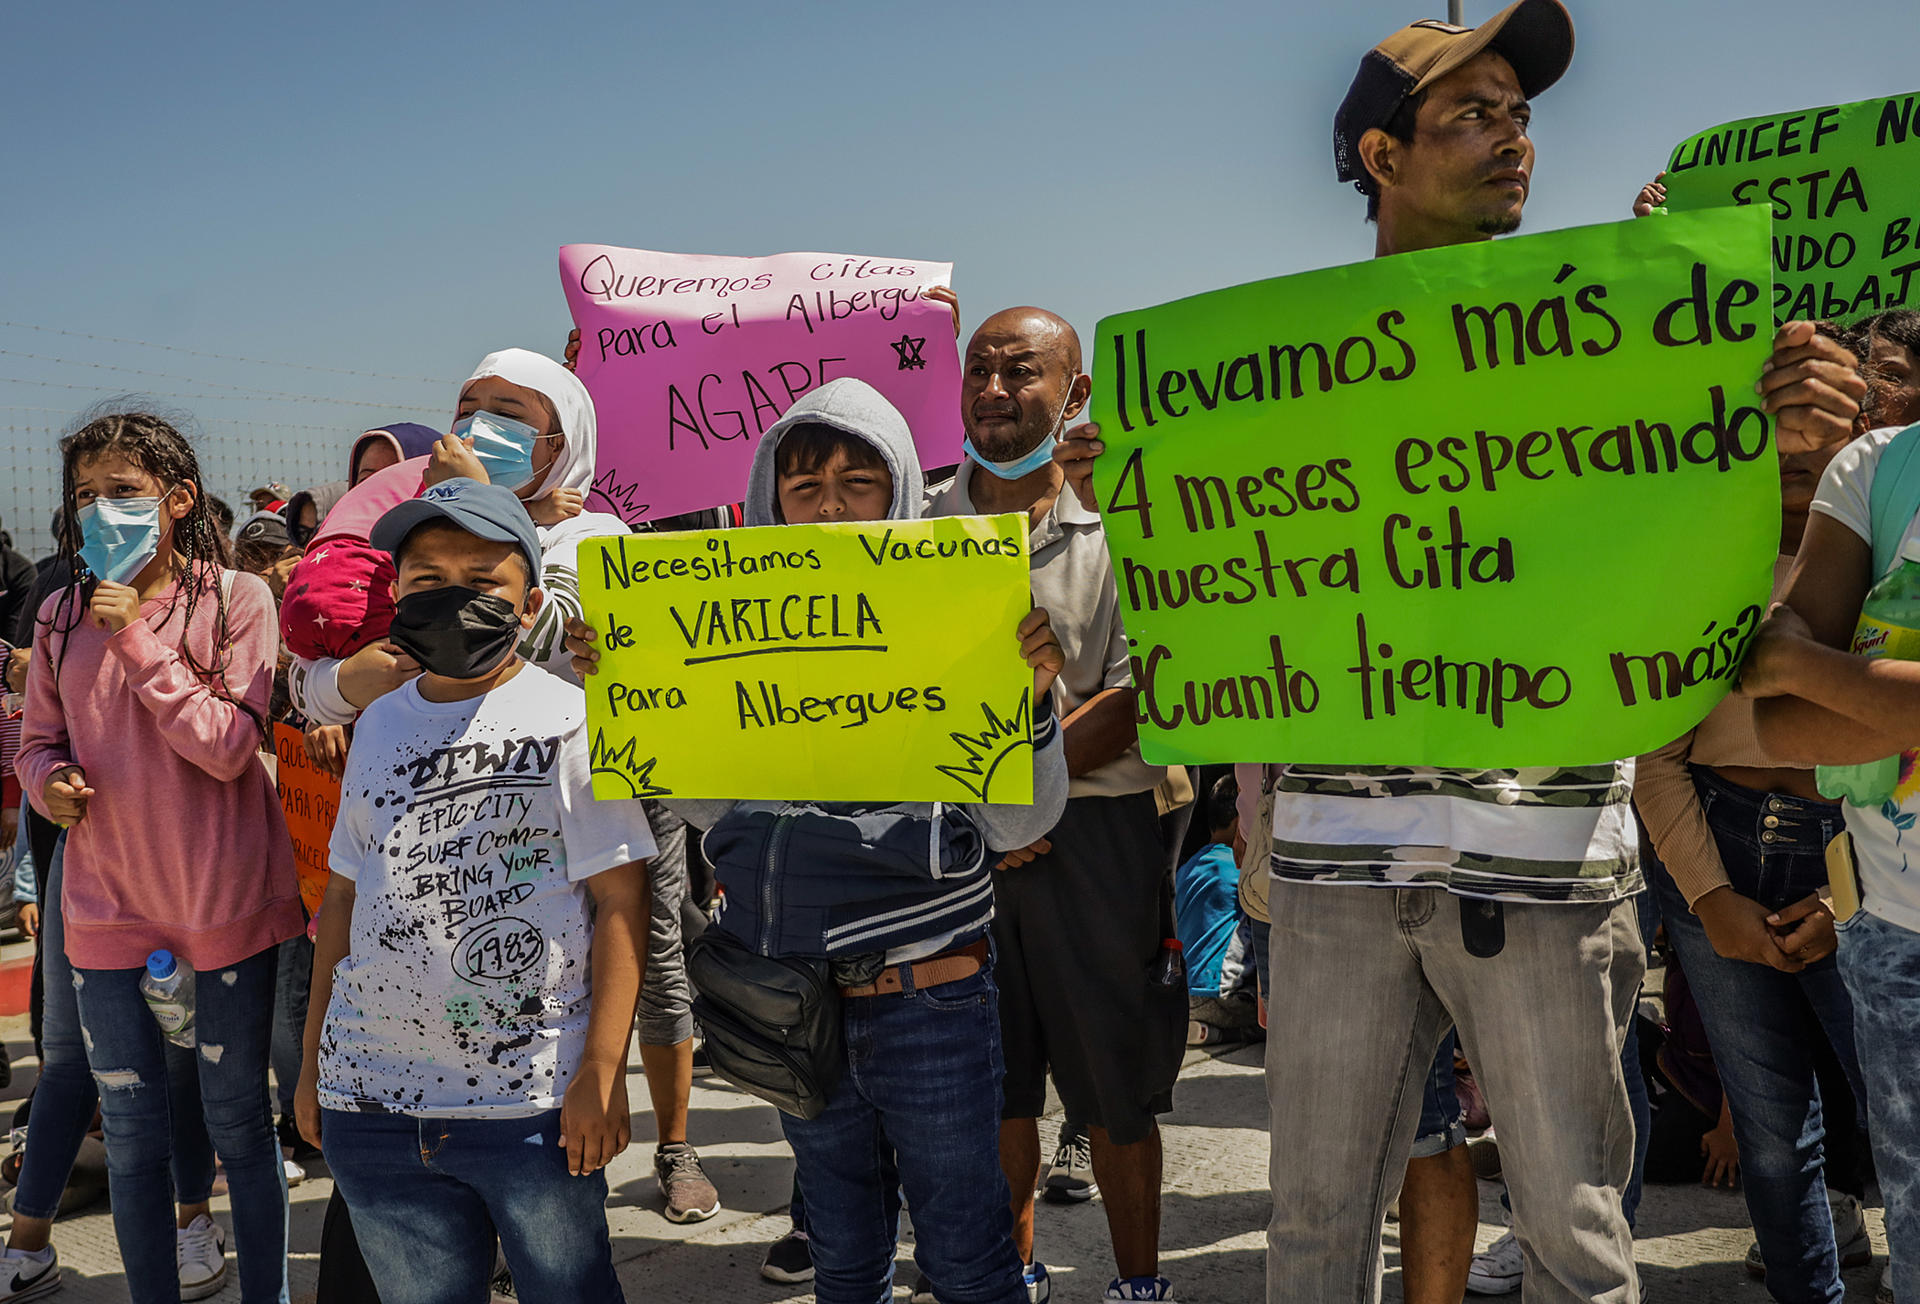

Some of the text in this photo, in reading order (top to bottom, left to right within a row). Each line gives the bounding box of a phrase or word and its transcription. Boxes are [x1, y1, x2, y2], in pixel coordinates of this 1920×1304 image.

[1671, 96, 1920, 173] UNICEF N
[1731, 166, 1869, 220] ESTA
[1881, 217, 1920, 260] B
[580, 254, 916, 301] Queremos citas
[597, 320, 677, 362] para
[701, 303, 740, 335] el
[1113, 261, 1760, 432] llevamos más de
[1106, 385, 1768, 539] 4 meses esperando
[600, 528, 1020, 590] Necesitamos Vacunas
[1122, 505, 1516, 612] nuestra Cita
[605, 592, 884, 652] de VARICELA
[1852, 629, 1890, 655] Squirt
[1346, 612, 1572, 729] tiempo
[1609, 603, 1763, 706] más?
[607, 679, 946, 730] Para Albergues
[418, 793, 534, 836] EPIC CITY
[405, 836, 473, 873] SURF
[408, 862, 494, 900] BRING
[440, 883, 535, 930] BOARD
[467, 929, 541, 977] 1983
